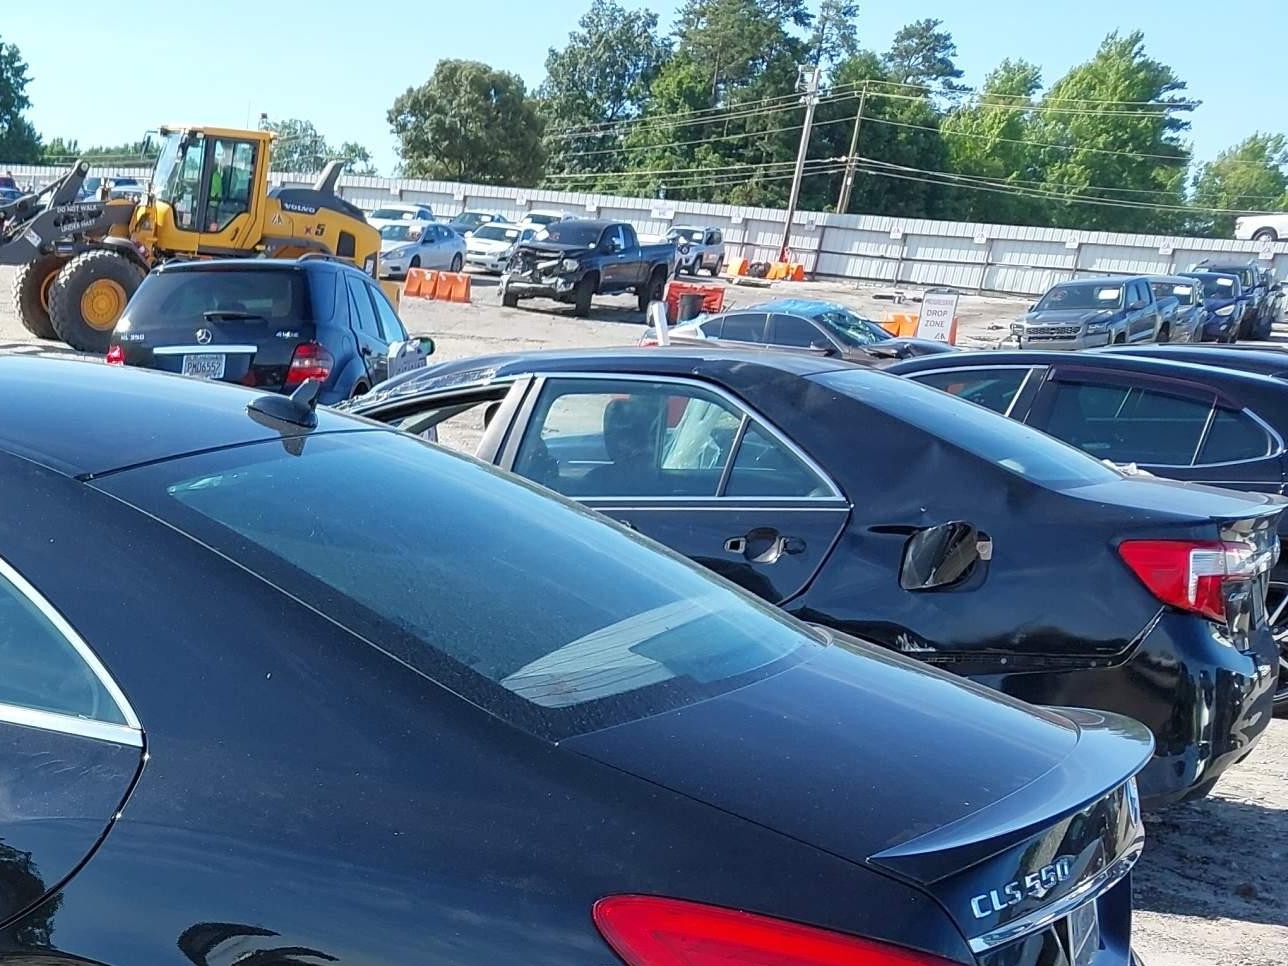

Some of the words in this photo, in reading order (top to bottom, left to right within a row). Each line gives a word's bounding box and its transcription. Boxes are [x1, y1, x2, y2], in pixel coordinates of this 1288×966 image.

[67, 204, 79, 212] NOT
[284, 203, 316, 213] VOLVO
[60, 222, 80, 232] UNDER
[926, 309, 948, 317] DROP
[924, 319, 944, 328] ZONE
[970, 881, 1022, 919] CLS
[1024, 859, 1070, 896] 550
